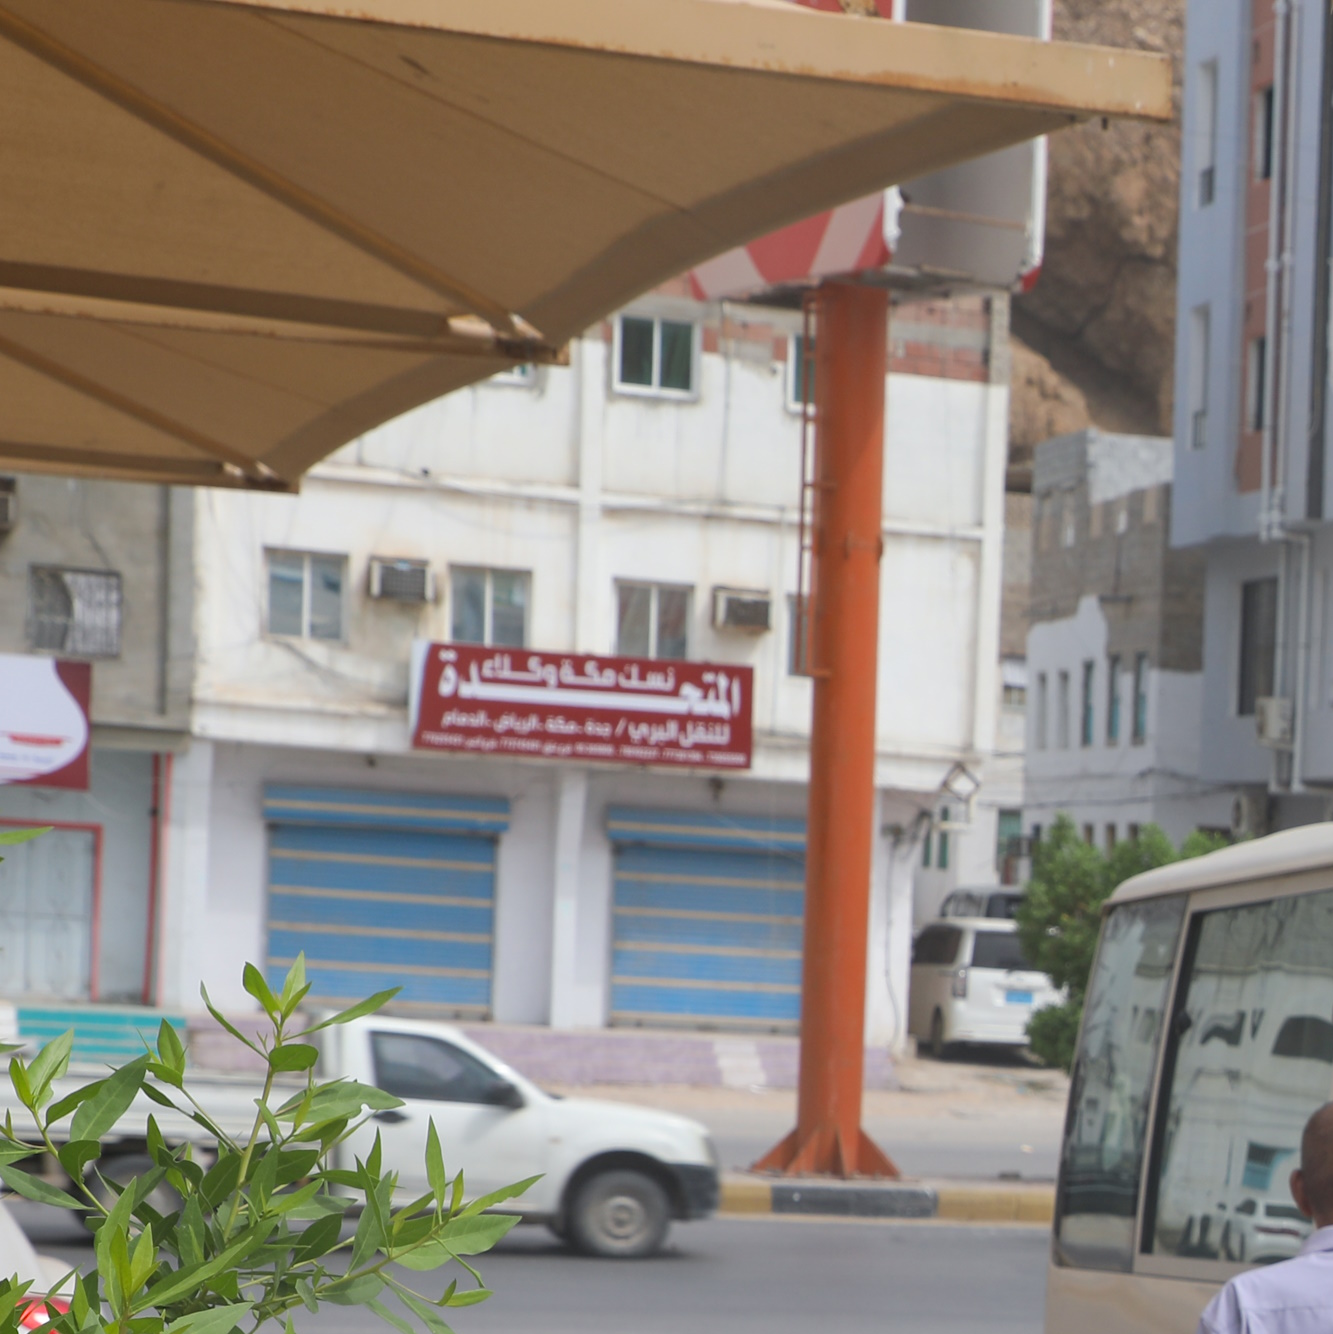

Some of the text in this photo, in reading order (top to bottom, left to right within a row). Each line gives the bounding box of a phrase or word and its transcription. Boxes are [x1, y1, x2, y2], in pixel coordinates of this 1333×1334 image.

[438, 649, 742, 719] المتحدة
[481, 652, 559, 689] وكلاء
[559, 656, 617, 687] مكة
[584, 716, 612, 740] جدة
[628, 719, 678, 746] البري
[678, 721, 731, 748] للنقل
